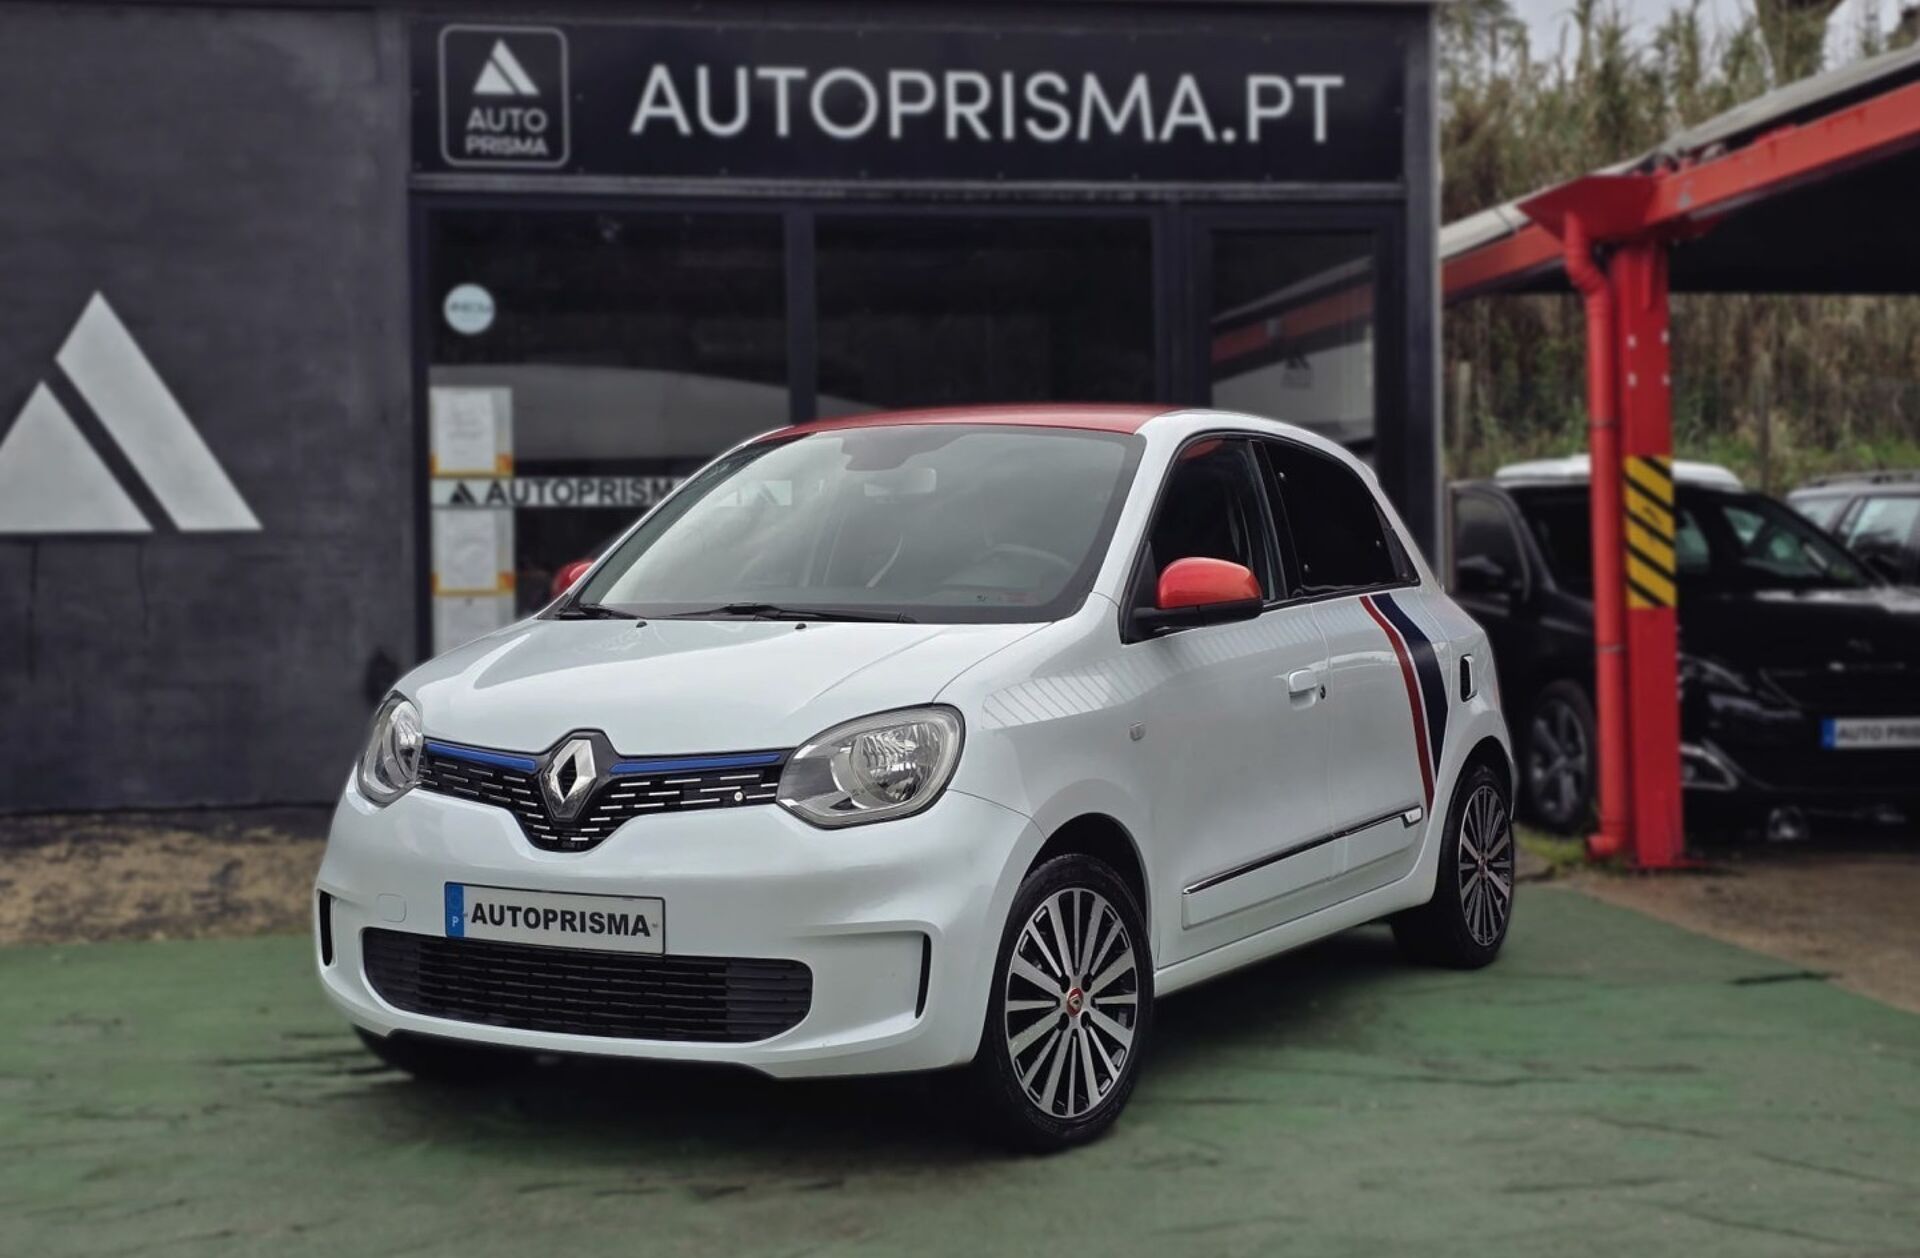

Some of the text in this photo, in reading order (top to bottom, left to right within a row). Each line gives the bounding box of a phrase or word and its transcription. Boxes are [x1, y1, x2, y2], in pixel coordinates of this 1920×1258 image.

[630, 65, 1344, 143] AUTOPRISMA.PT
[465, 107, 548, 133] AUTO
[465, 134, 549, 155] PRISMA
[486, 479, 676, 505] AUTOPRISM
[452, 902, 652, 937] P AUTOPRISMA
